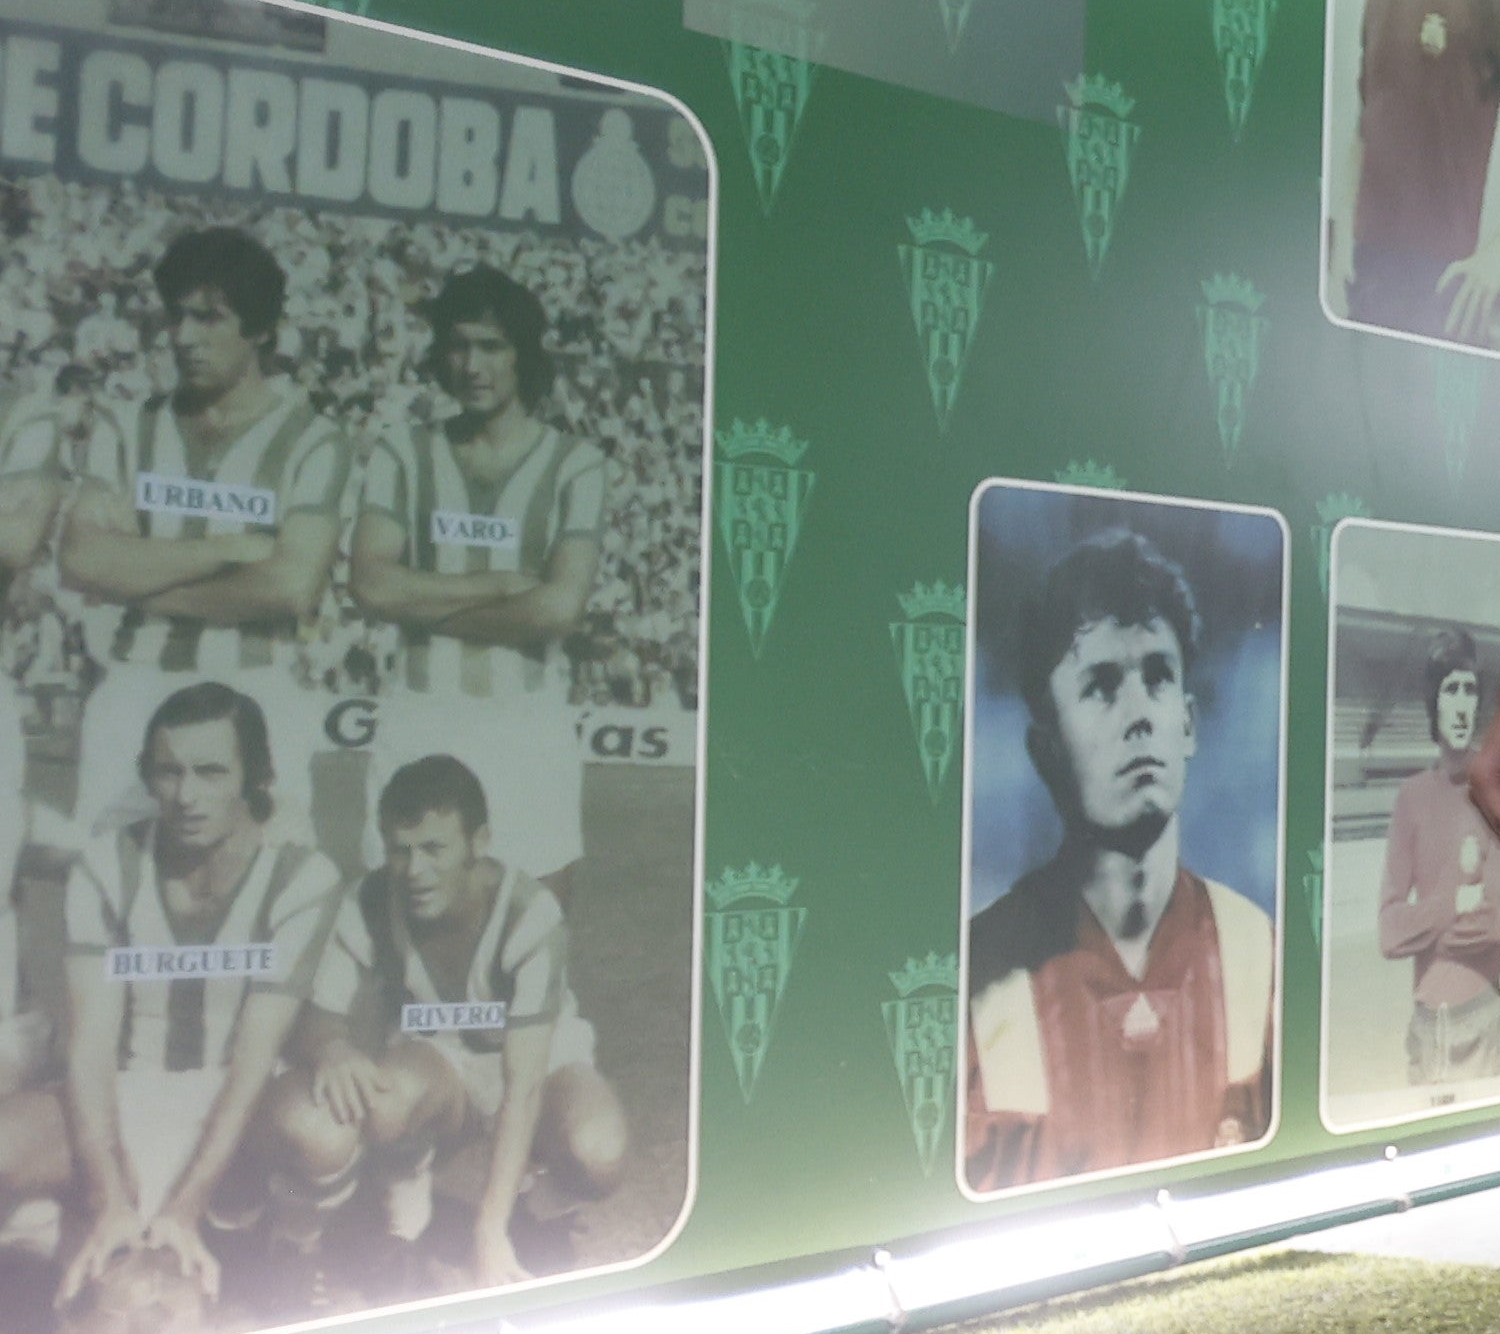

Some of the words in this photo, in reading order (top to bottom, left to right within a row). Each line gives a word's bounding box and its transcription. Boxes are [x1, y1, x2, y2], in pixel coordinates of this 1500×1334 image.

[76, 50, 563, 225] CORDOBA
[142, 482, 271, 518] URBANO
[113, 947, 273, 975] BURGUETE
[405, 1005, 502, 1030] RIVERO
